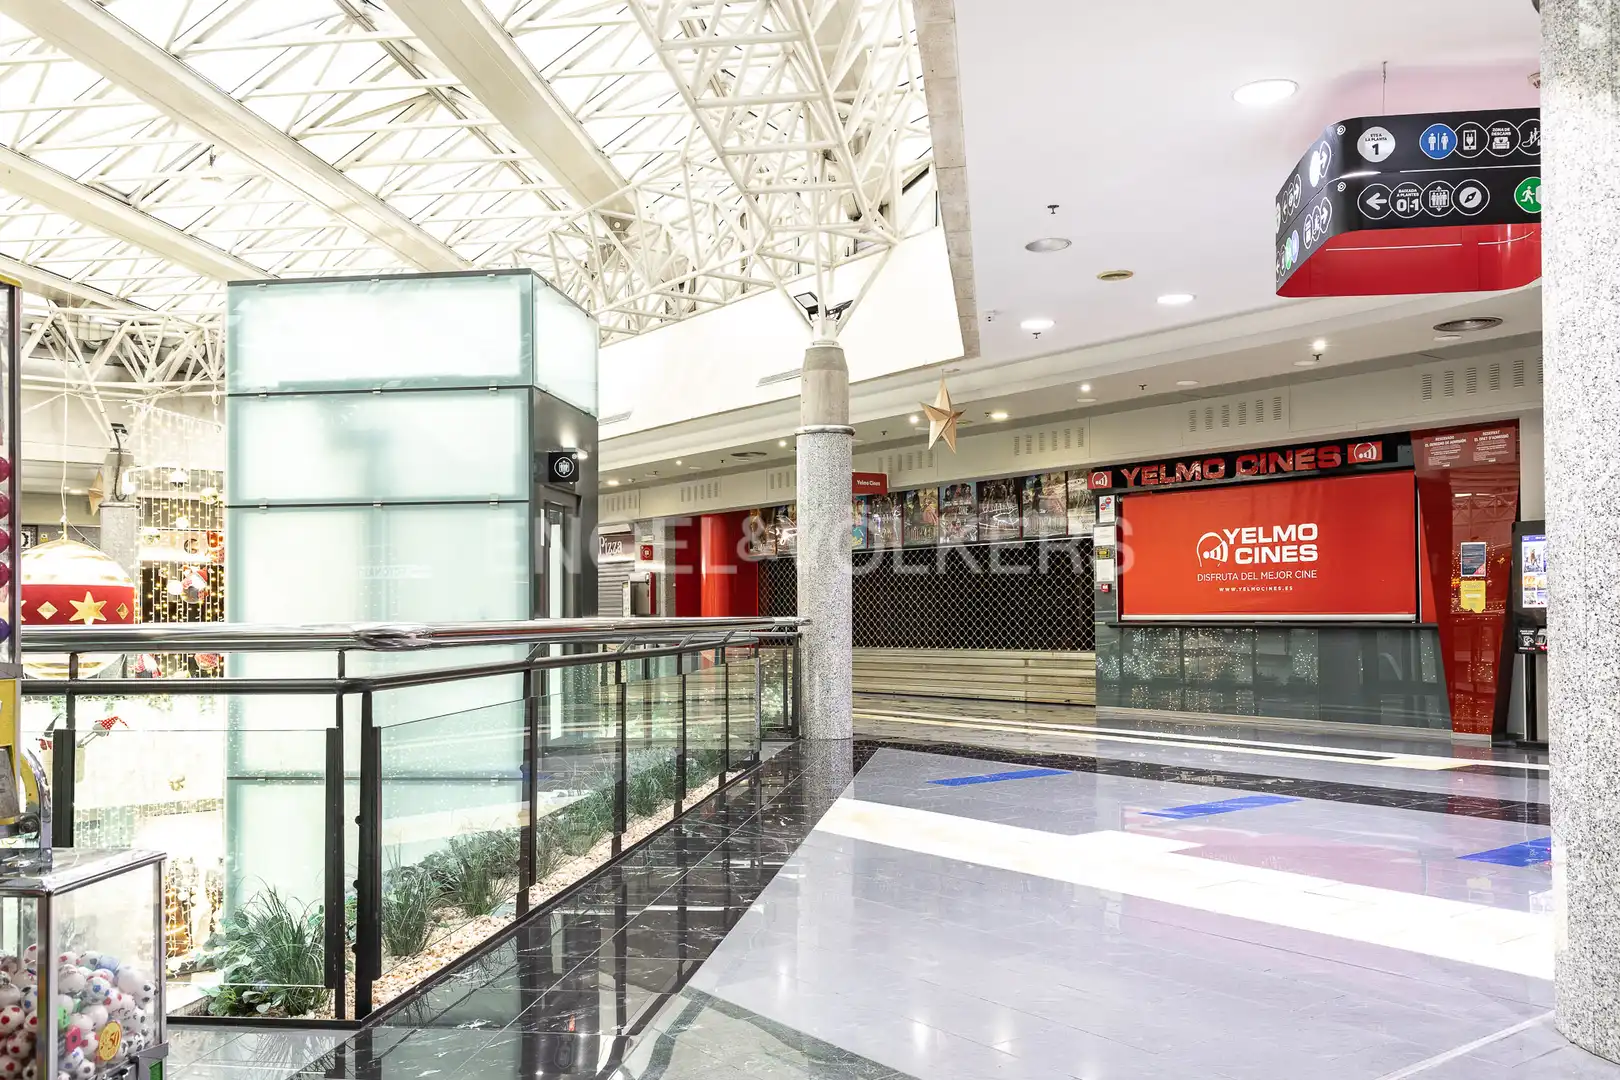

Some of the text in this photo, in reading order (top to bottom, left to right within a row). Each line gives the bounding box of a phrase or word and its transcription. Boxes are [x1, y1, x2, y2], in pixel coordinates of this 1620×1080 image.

[1371, 143, 1379, 156] 1
[1120, 445, 1341, 487] YELMO CINES
[1222, 523, 1318, 545] YELMO
[598, 535, 623, 555] Pizza
[1235, 544, 1318, 565] CINES
[1197, 569, 1317, 582] DISFRUTA DEL MEJOR CINE
[1219, 585, 1293, 593] WWW.YELMOCINES.ES
